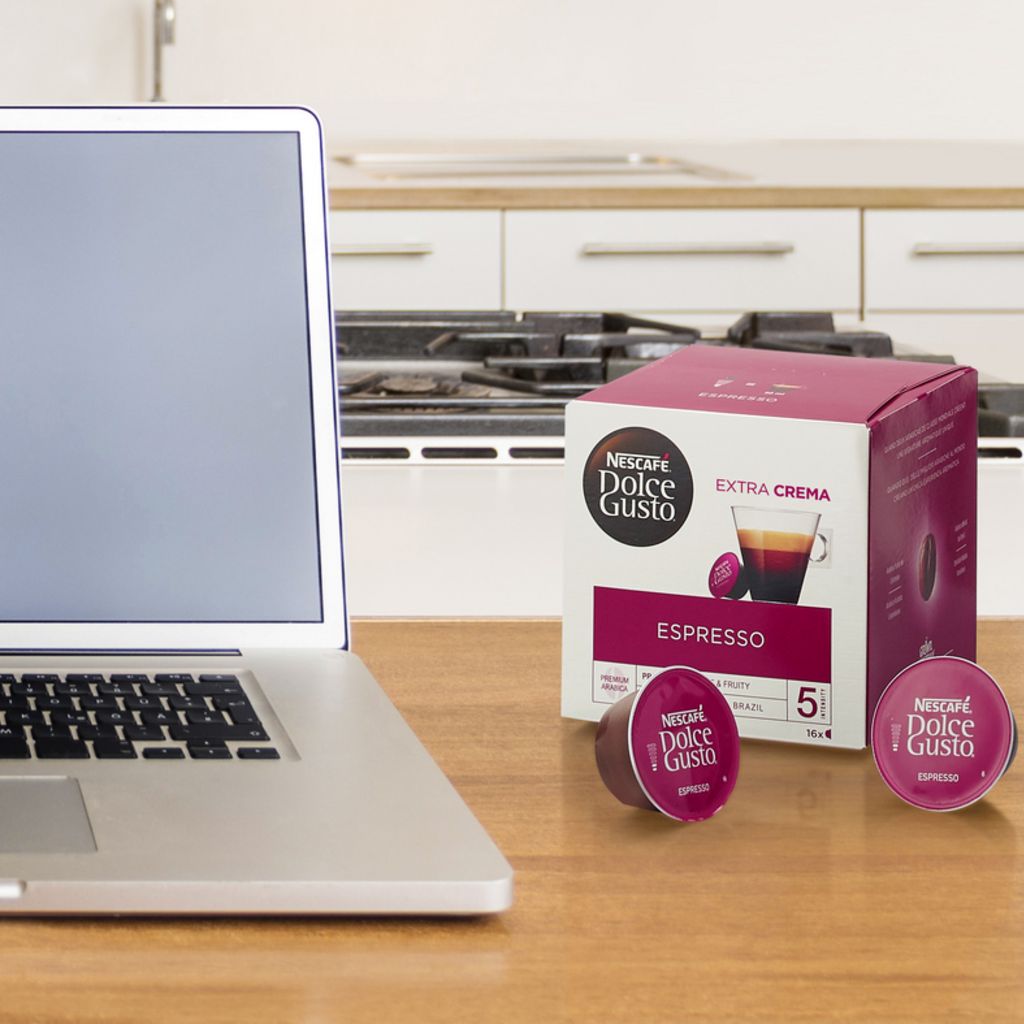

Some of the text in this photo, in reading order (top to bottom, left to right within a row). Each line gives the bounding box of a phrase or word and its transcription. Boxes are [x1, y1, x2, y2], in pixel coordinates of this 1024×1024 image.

[606, 451, 671, 473] NESCAFÉ
[598, 469, 676, 500] Dolce
[715, 478, 831, 502] EXTRA CREMA
[599, 494, 676, 522] Gusto
[657, 622, 766, 649] ESPRESSO
[600, 674, 629, 683] PREMIUM
[601, 683, 629, 692] ARABICA
[723, 680, 751, 690] FRUITY
[732, 701, 764, 712] BRAZIL
[797, 686, 818, 718] 5
[914, 696, 972, 714] NESCAFÉ
[661, 704, 707, 728] NESCAFÉ
[907, 714, 975, 737] Dolce
[659, 726, 714, 753] Dolce
[806, 728, 824, 739] 16x
[907, 733, 975, 758] Gusto
[664, 746, 717, 773] Gusto
[917, 772, 959, 783] ESPRESSO
[678, 783, 711, 797] ESPRESSO
